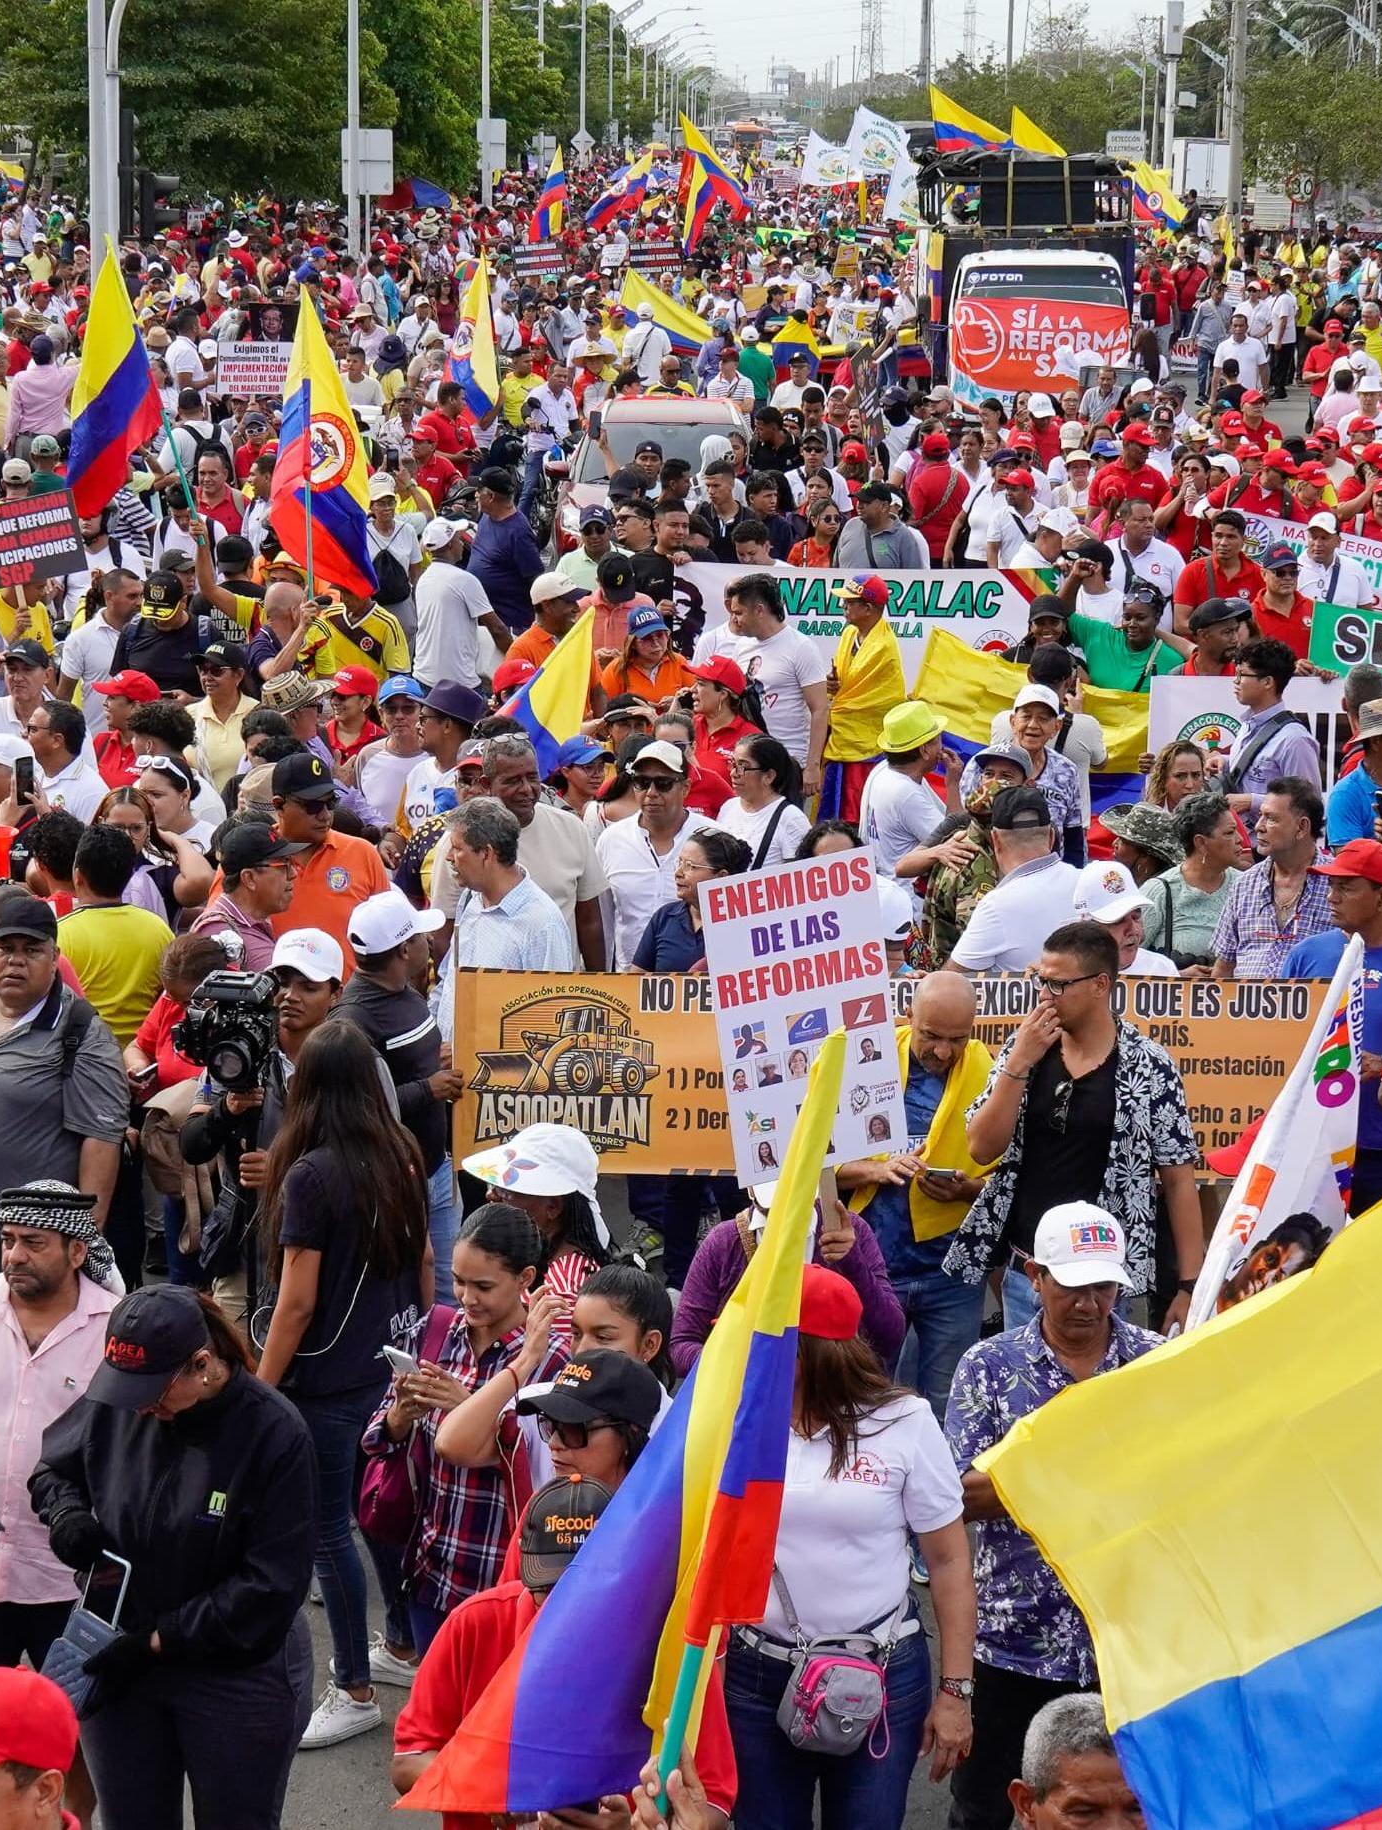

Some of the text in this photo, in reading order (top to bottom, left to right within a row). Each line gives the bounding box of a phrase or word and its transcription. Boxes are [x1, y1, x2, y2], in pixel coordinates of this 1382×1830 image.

[1291, 178, 1314, 196] 30
[1011, 303, 1083, 330] SÍ A LA
[234, 344, 279, 354] Exigimos el
[1008, 326, 1132, 352] REFORMA
[262, 355, 279, 363] TOTAL
[1007, 352, 1033, 362] A LA
[223, 363, 288, 373] IMPLEMENTACIÓN
[229, 384, 280, 393] DEL MAGISTERIO
[232, 375, 259, 383] MODELO
[259, 375, 268, 383] DE
[19, 507, 72, 532] REFORMA
[20, 523, 75, 546] GENERAL
[778, 578, 1006, 619] NALRALAC
[708, 856, 872, 925] ENEMIGOS
[750, 910, 841, 957] DE LAS
[716, 940, 885, 1010] REFORMAS
[555, 986, 567, 994] DE
[640, 977, 676, 1013] NO
[974, 982, 1041, 1018] EXIGI
[1136, 982, 1184, 1018] QUE
[1190, 983, 1222, 1018] ES
[1229, 984, 1309, 1020] JUSTO
[1149, 1019, 1194, 1048] PAÍS.
[1179, 1055, 1286, 1079] prestación
[665, 1108, 678, 1130] 2
[1229, 1106, 1242, 1124] a
[1069, 1226, 1115, 1244] PETRO
[840, 1469, 880, 1485] ADEA
[545, 1514, 598, 1533] fecod
[556, 1533, 572, 1544] 65
